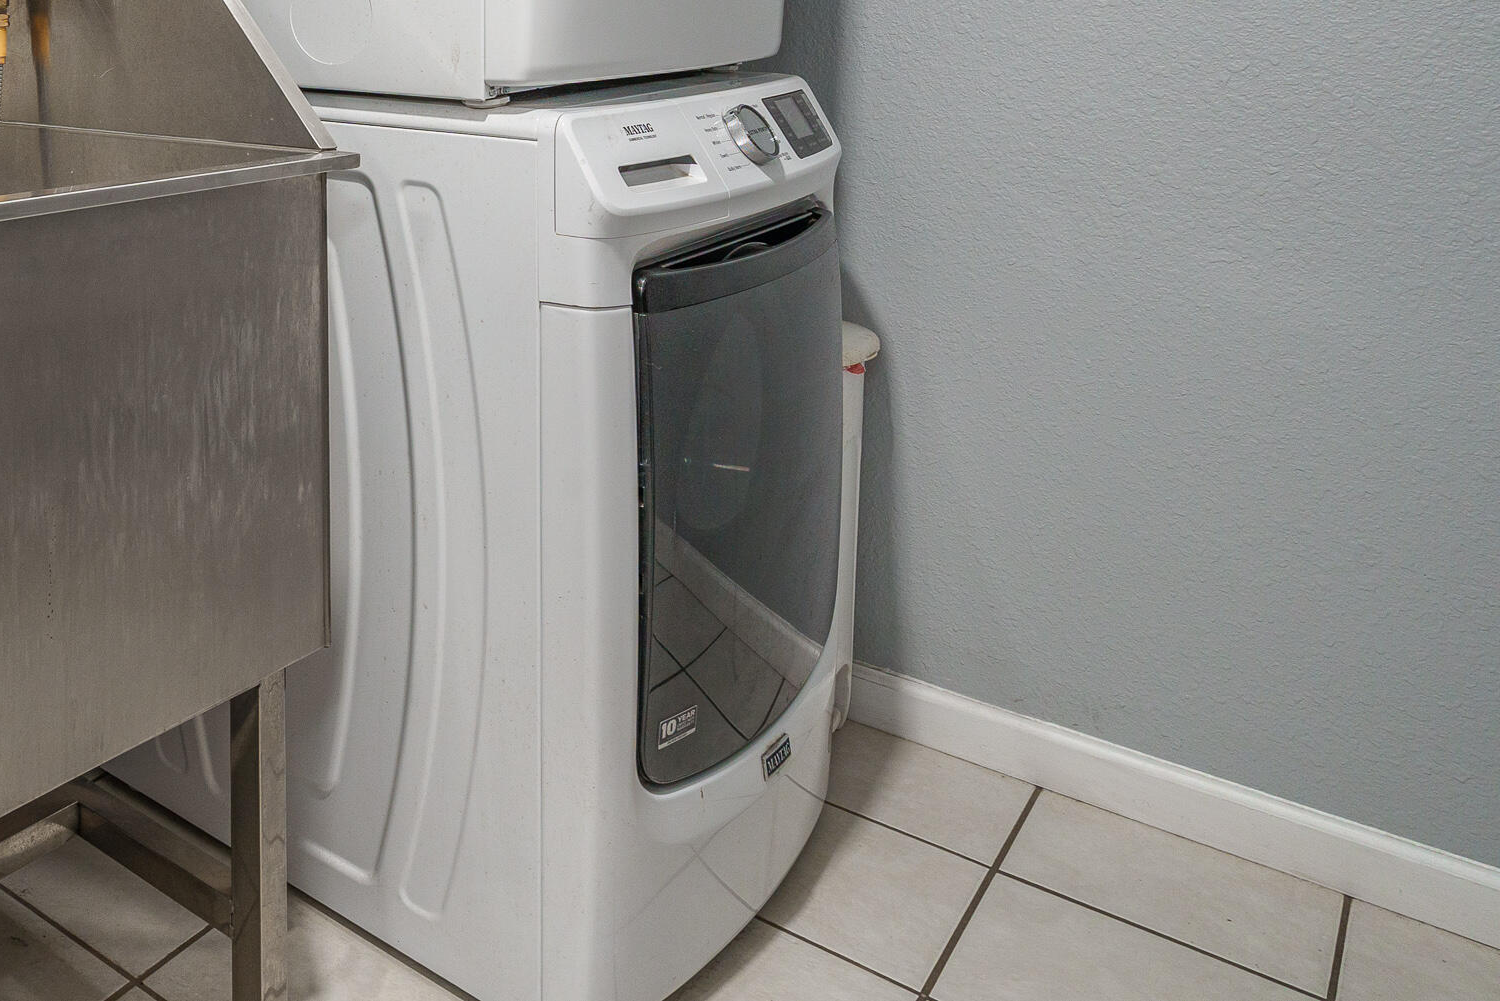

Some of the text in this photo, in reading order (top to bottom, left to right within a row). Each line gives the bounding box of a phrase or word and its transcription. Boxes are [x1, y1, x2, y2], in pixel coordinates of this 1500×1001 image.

[622, 122, 654, 136] MAYTAG
[661, 719, 677, 739] 10
[678, 709, 696, 723] YEAR
[767, 742, 790, 774] MAYTAG
